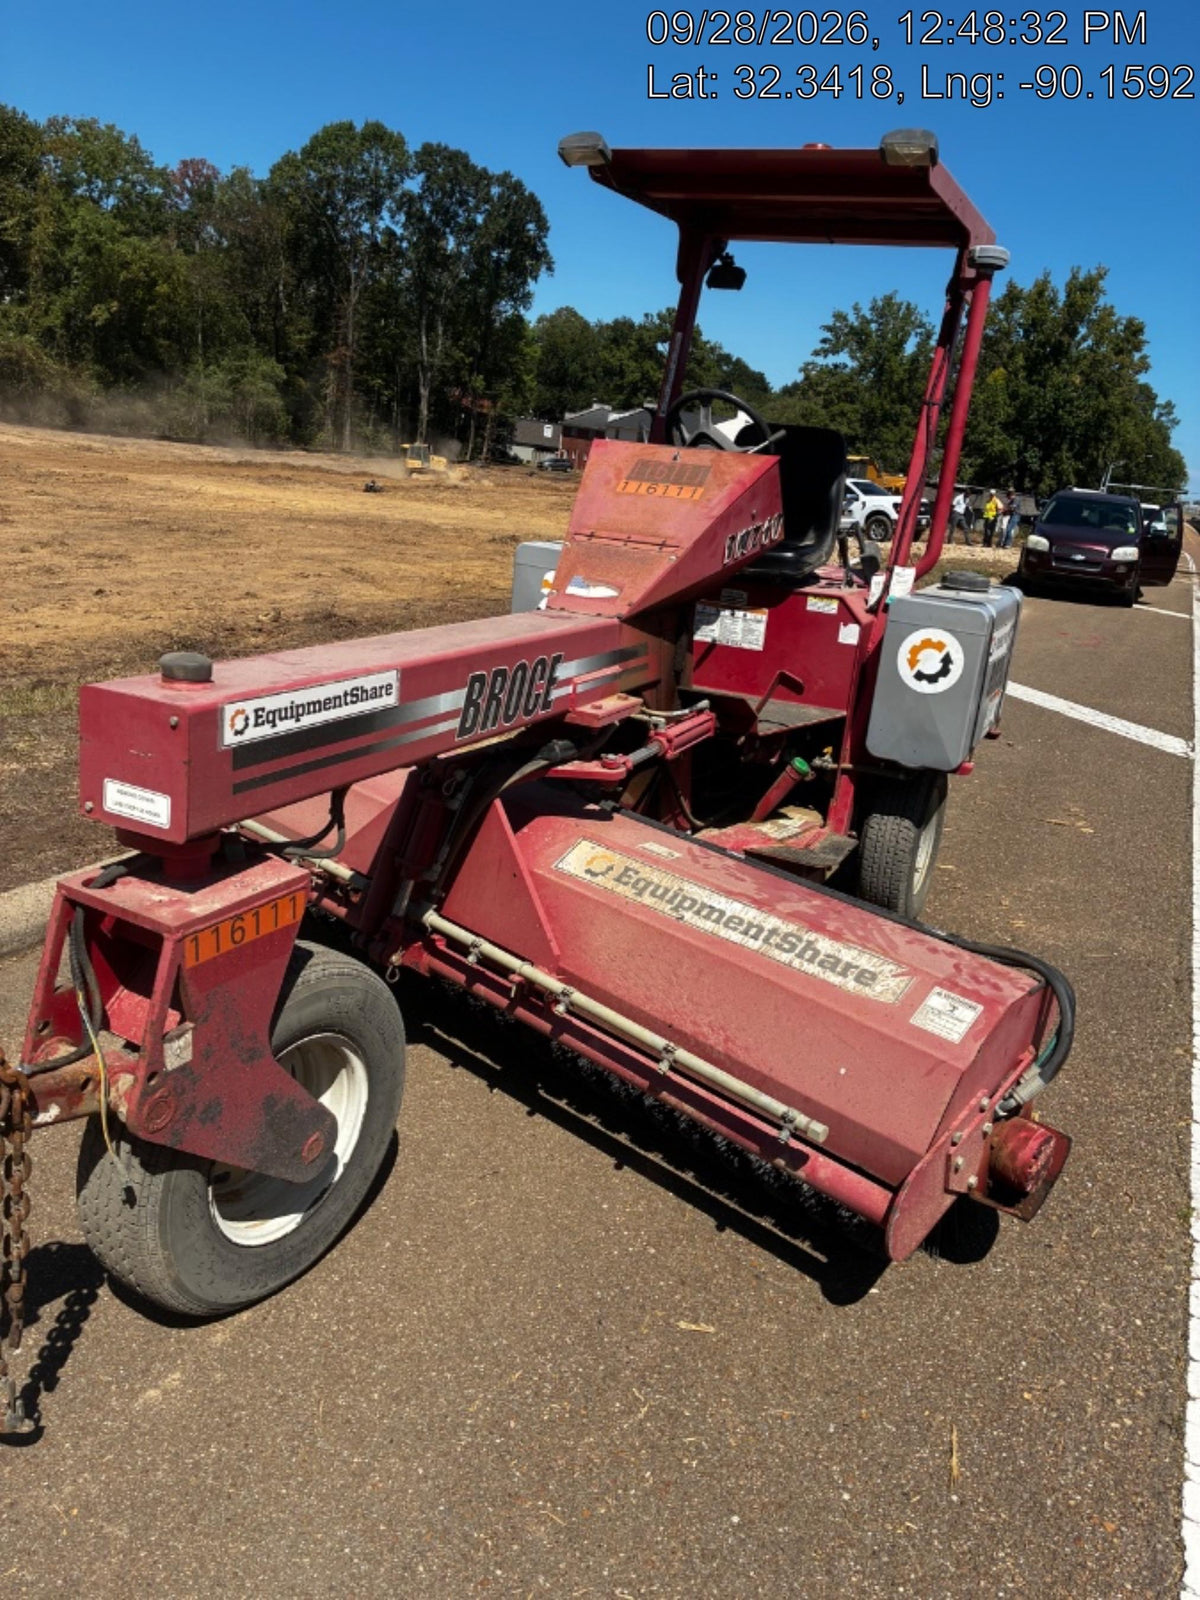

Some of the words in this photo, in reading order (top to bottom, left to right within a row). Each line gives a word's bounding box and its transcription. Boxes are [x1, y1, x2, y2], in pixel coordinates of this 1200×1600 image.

[621, 481, 698, 498] 116111
[253, 682, 393, 728] EquipmentShare
[455, 652, 565, 741] BROCE
[190, 895, 297, 963] 116111
[614, 865, 879, 987] EquipmentShare
